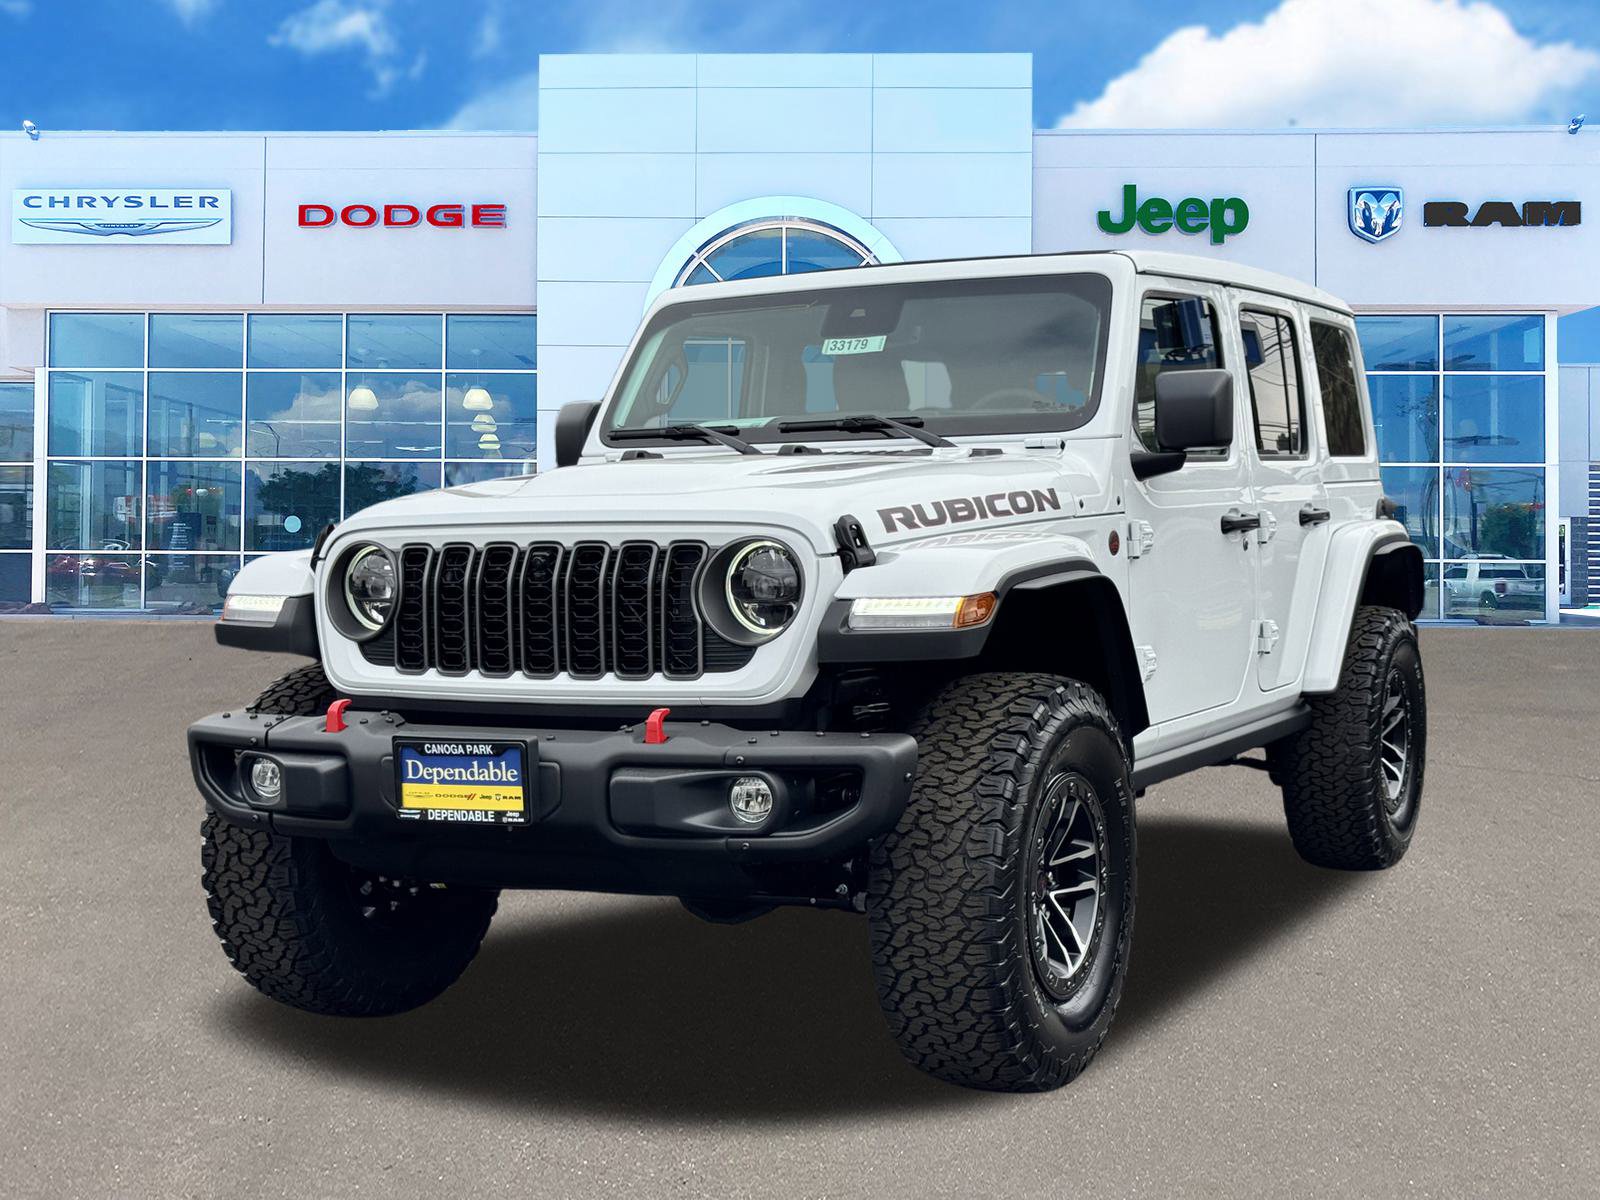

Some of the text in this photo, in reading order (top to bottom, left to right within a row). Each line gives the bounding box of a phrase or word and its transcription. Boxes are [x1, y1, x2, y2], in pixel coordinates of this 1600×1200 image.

[22, 195, 220, 209] CHRYSLER
[1423, 201, 1582, 227] RAM
[298, 204, 507, 228] DODGE
[1097, 184, 1250, 245] Jeep
[829, 338, 869, 352] 33179
[876, 487, 1062, 534] RUBICON
[424, 743, 494, 755] CANOGA PARK
[405, 759, 518, 785] Dependable
[427, 809, 496, 822] DEPENDABLE
